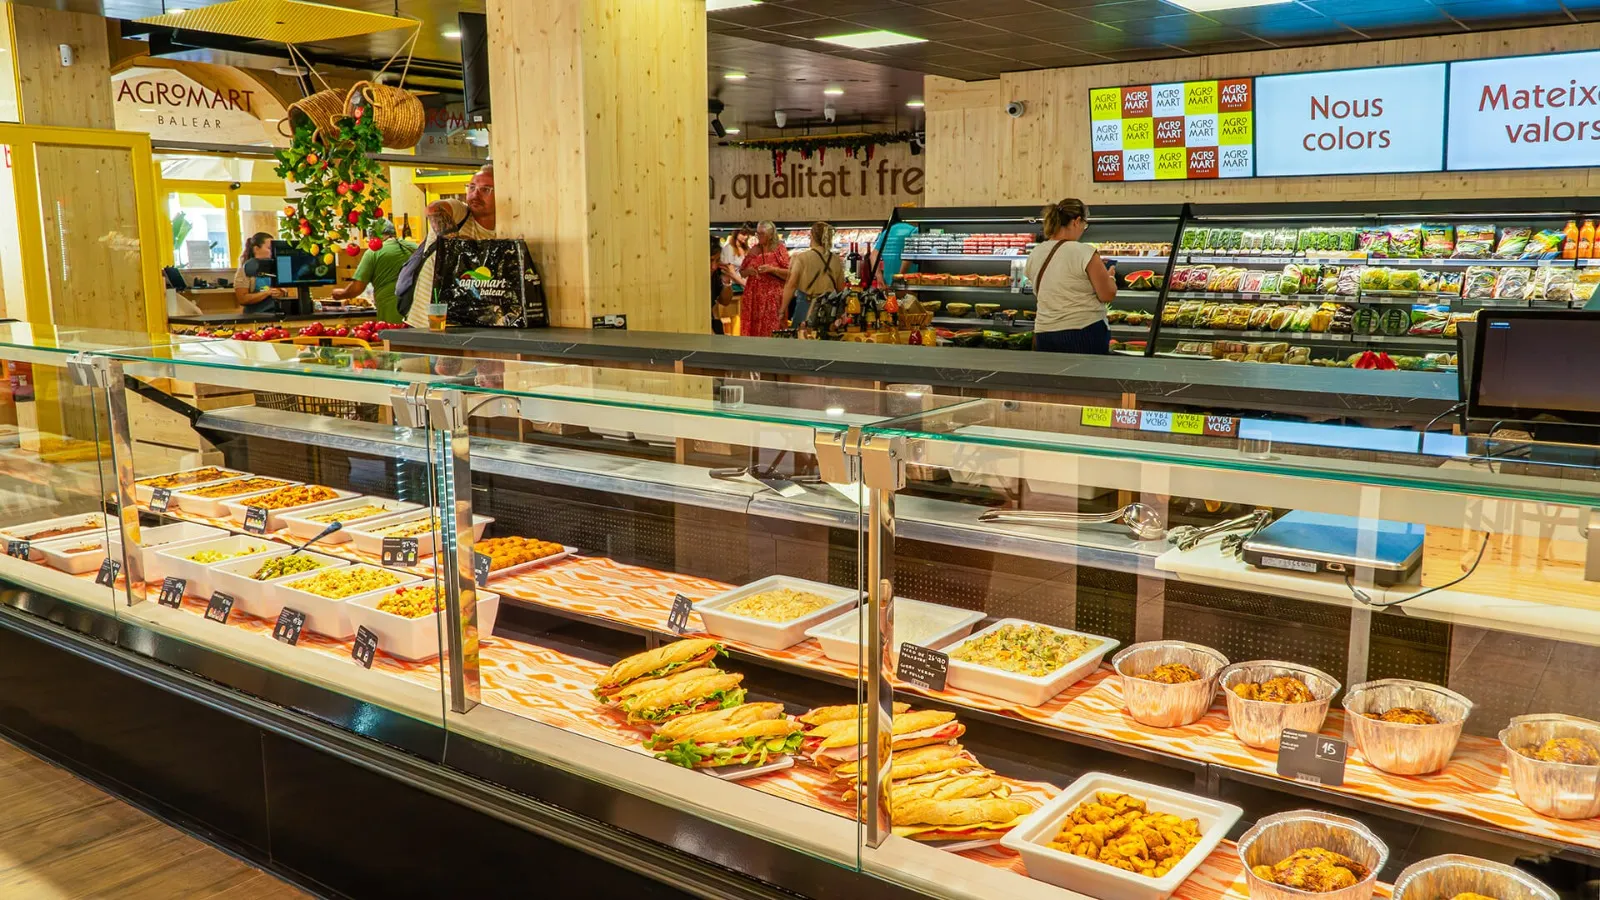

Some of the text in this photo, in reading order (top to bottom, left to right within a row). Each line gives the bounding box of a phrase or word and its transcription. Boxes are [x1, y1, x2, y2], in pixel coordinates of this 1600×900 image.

[1157, 89, 1180, 99] AGRO
[1189, 87, 1213, 97] AGRO
[1222, 84, 1247, 94] AGRO
[117, 80, 254, 112] AGROMART
[1095, 93, 1117, 102] AGRO
[1125, 91, 1147, 101] AGRO
[1188, 96, 1213, 105] MART
[1222, 92, 1248, 103] MART
[1478, 79, 1600, 112] Mateix
[1094, 102, 1117, 111] MART
[1124, 100, 1149, 110] MART
[1156, 98, 1180, 107] MART
[1310, 95, 1384, 121] Nous
[158, 115, 221, 129] BALEAR
[1126, 122, 1149, 132] AGRO
[1157, 120, 1181, 130] AGRO
[1189, 119, 1213, 129] AGRO
[1223, 117, 1247, 127] AGRO
[1096, 125, 1118, 134] AGRO
[1157, 129, 1182, 139] MART
[1189, 128, 1213, 137] MART
[1222, 126, 1248, 136] MART
[1505, 116, 1600, 144] valors
[1096, 133, 1118, 142] MART
[1126, 131, 1150, 140] MART
[1302, 126, 1391, 151] colors
[1098, 154, 1119, 164] AGRO
[1128, 154, 1150, 163] AGRO
[1159, 152, 1182, 161] AGRO
[1190, 150, 1214, 160] AGRO
[1224, 149, 1248, 159] AGRO
[1097, 163, 1120, 172] MART
[1127, 162, 1150, 171] MART
[1158, 161, 1182, 170] MART
[1190, 160, 1215, 169] MART
[1222, 158, 1248, 168] MART
[731, 163, 851, 208] qualitat
[860, 160, 867, 196] i
[460, 278, 507, 289] agromart
[480, 288, 506, 297] balear
[1322, 742, 1336, 755] 15
